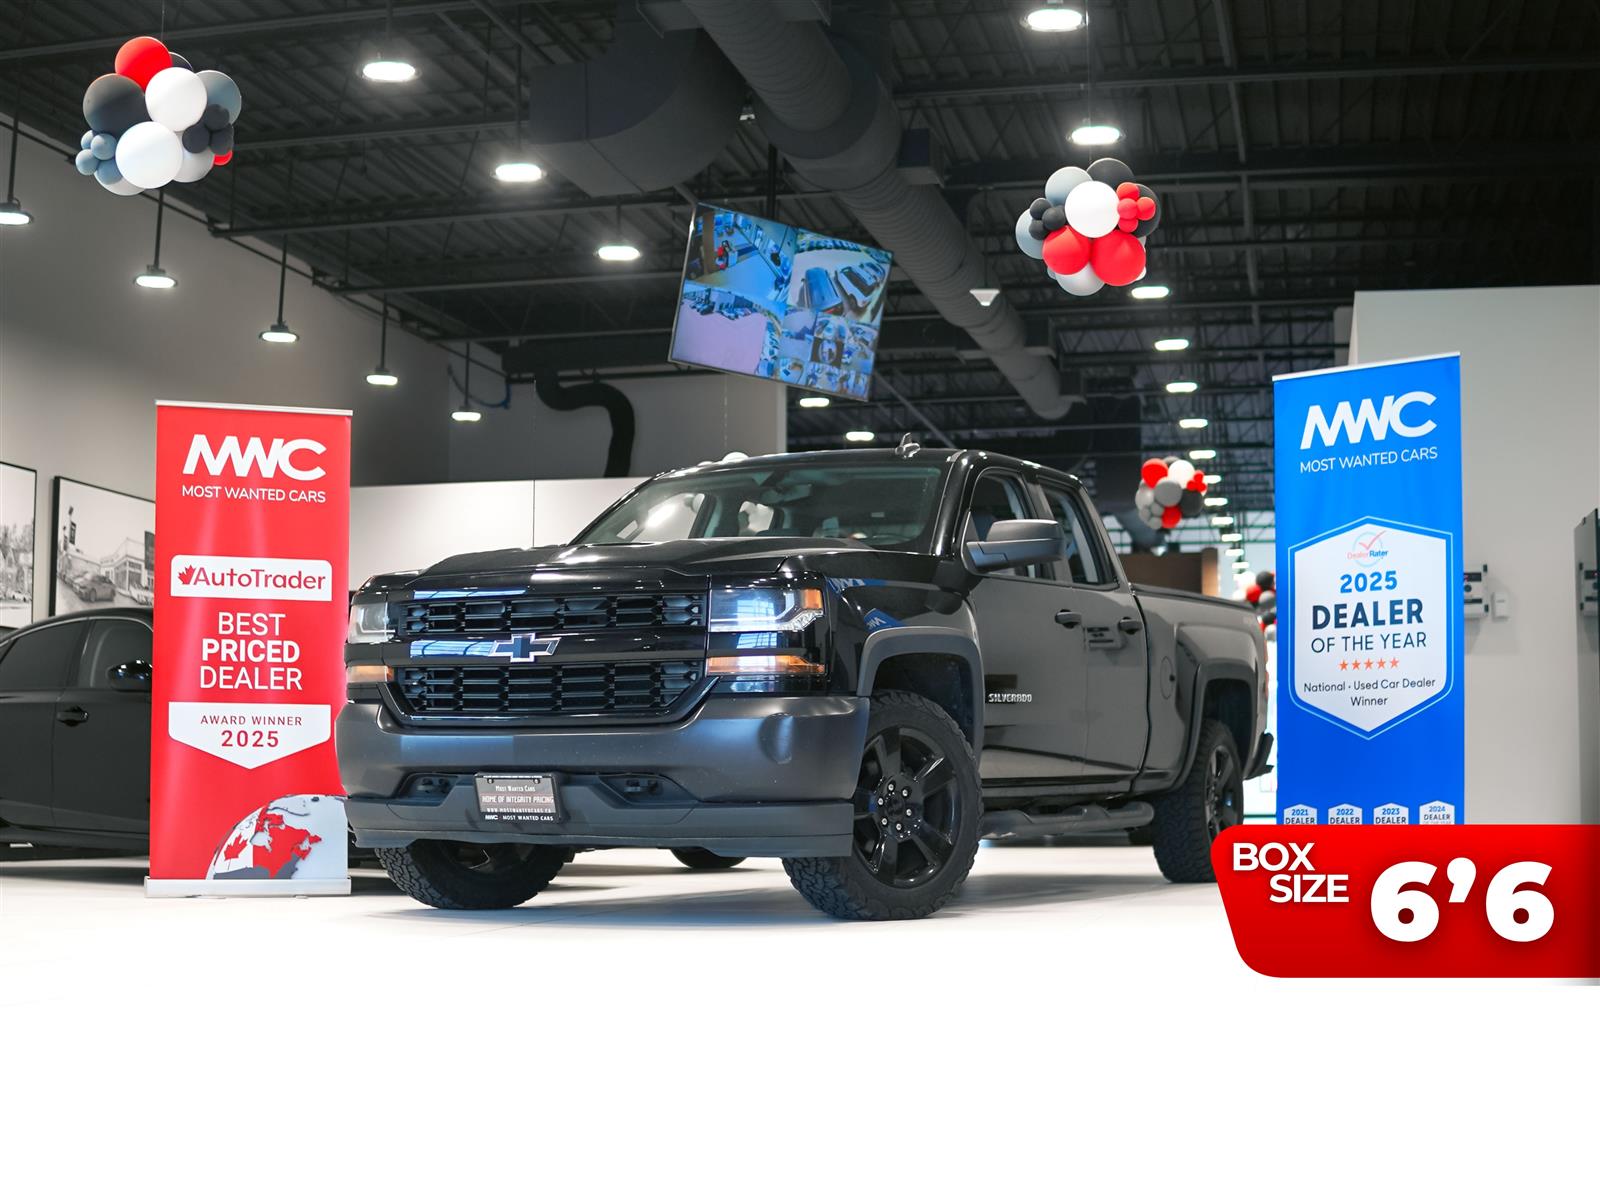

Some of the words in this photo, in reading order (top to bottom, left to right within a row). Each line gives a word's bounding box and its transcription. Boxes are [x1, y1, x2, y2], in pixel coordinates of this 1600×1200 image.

[1300, 391, 1437, 450] MWC
[182, 434, 327, 481] MWC
[1300, 457, 1336, 473] MOST
[1339, 451, 1398, 469] WANTED
[1401, 446, 1438, 463] CARS
[182, 485, 222, 498] MOST
[225, 486, 286, 501] WANTED
[289, 490, 326, 503] CARS
[193, 567, 326, 590] AutoTrader
[1339, 570, 1398, 594] 2025
[1312, 599, 1424, 630] DEALER
[218, 612, 286, 636] BEST
[202, 639, 300, 663] PRICED
[1311, 637, 1336, 654] OF
[1341, 634, 1374, 652] THE
[1380, 631, 1427, 650] YEAR
[200, 666, 303, 691] DEALER
[1304, 682, 1346, 693] National
[1353, 681, 1379, 691] Used
[1380, 679, 1400, 690] Car
[1402, 678, 1436, 689] Dealer
[988, 693, 1033, 703] SILVERADO
[1350, 696, 1388, 707] Winner
[200, 715, 247, 726] AWARD
[251, 716, 303, 727] WINNER
[221, 730, 280, 748] 2025
[482, 795, 497, 803] HOME
[497, 795, 505, 803] OF
[1285, 817, 1315, 825] DEALER
[1291, 808, 1309, 816] 2021
[1330, 817, 1361, 825] DEALER
[1336, 808, 1354, 816] 2022
[1375, 816, 1407, 825] DEALER
[1423, 813, 1451, 821] DEALER
